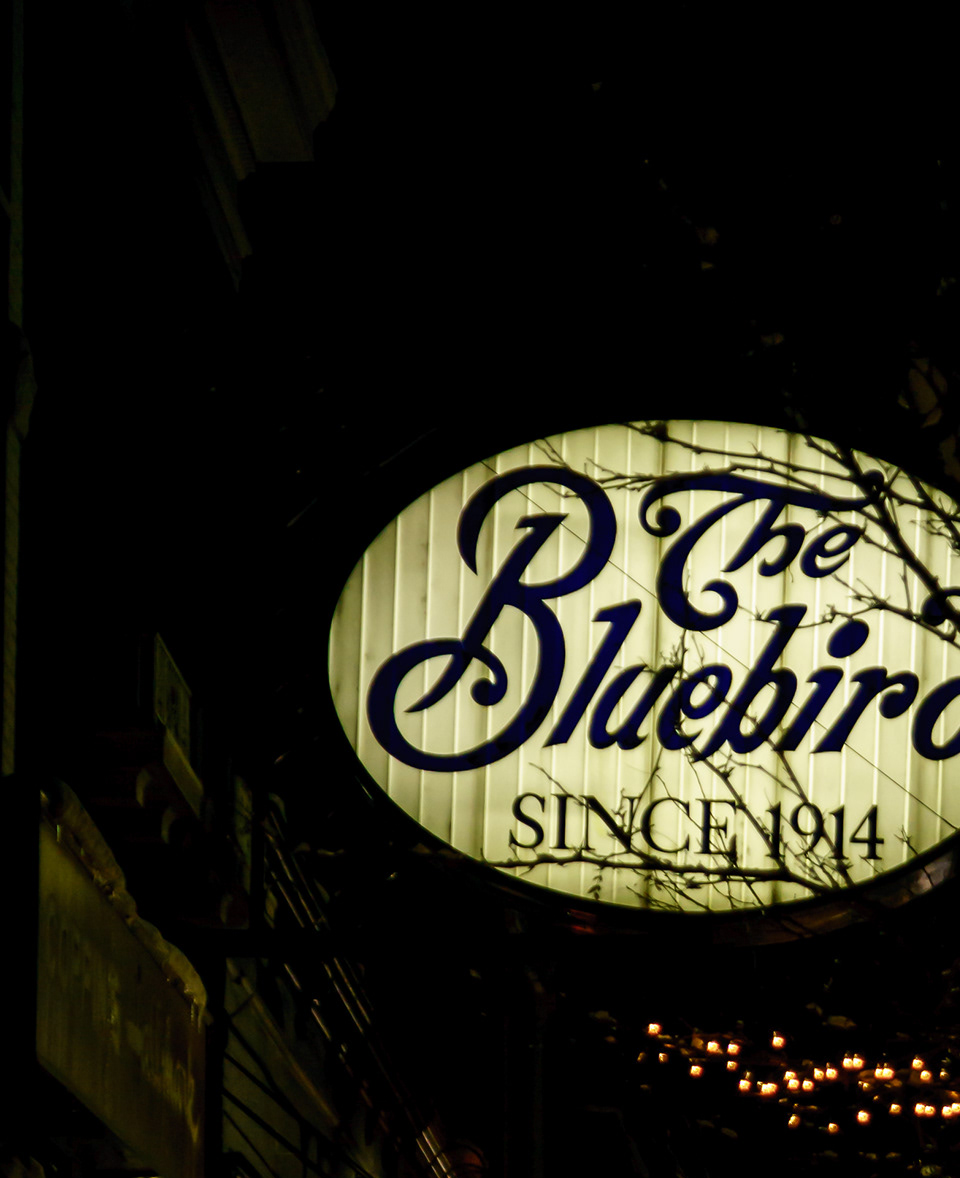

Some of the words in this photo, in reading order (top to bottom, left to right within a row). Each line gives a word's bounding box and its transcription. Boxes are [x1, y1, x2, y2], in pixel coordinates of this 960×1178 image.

[638, 470, 885, 632] The
[508, 792, 738, 857] SINCE
[767, 803, 885, 861] 1914
